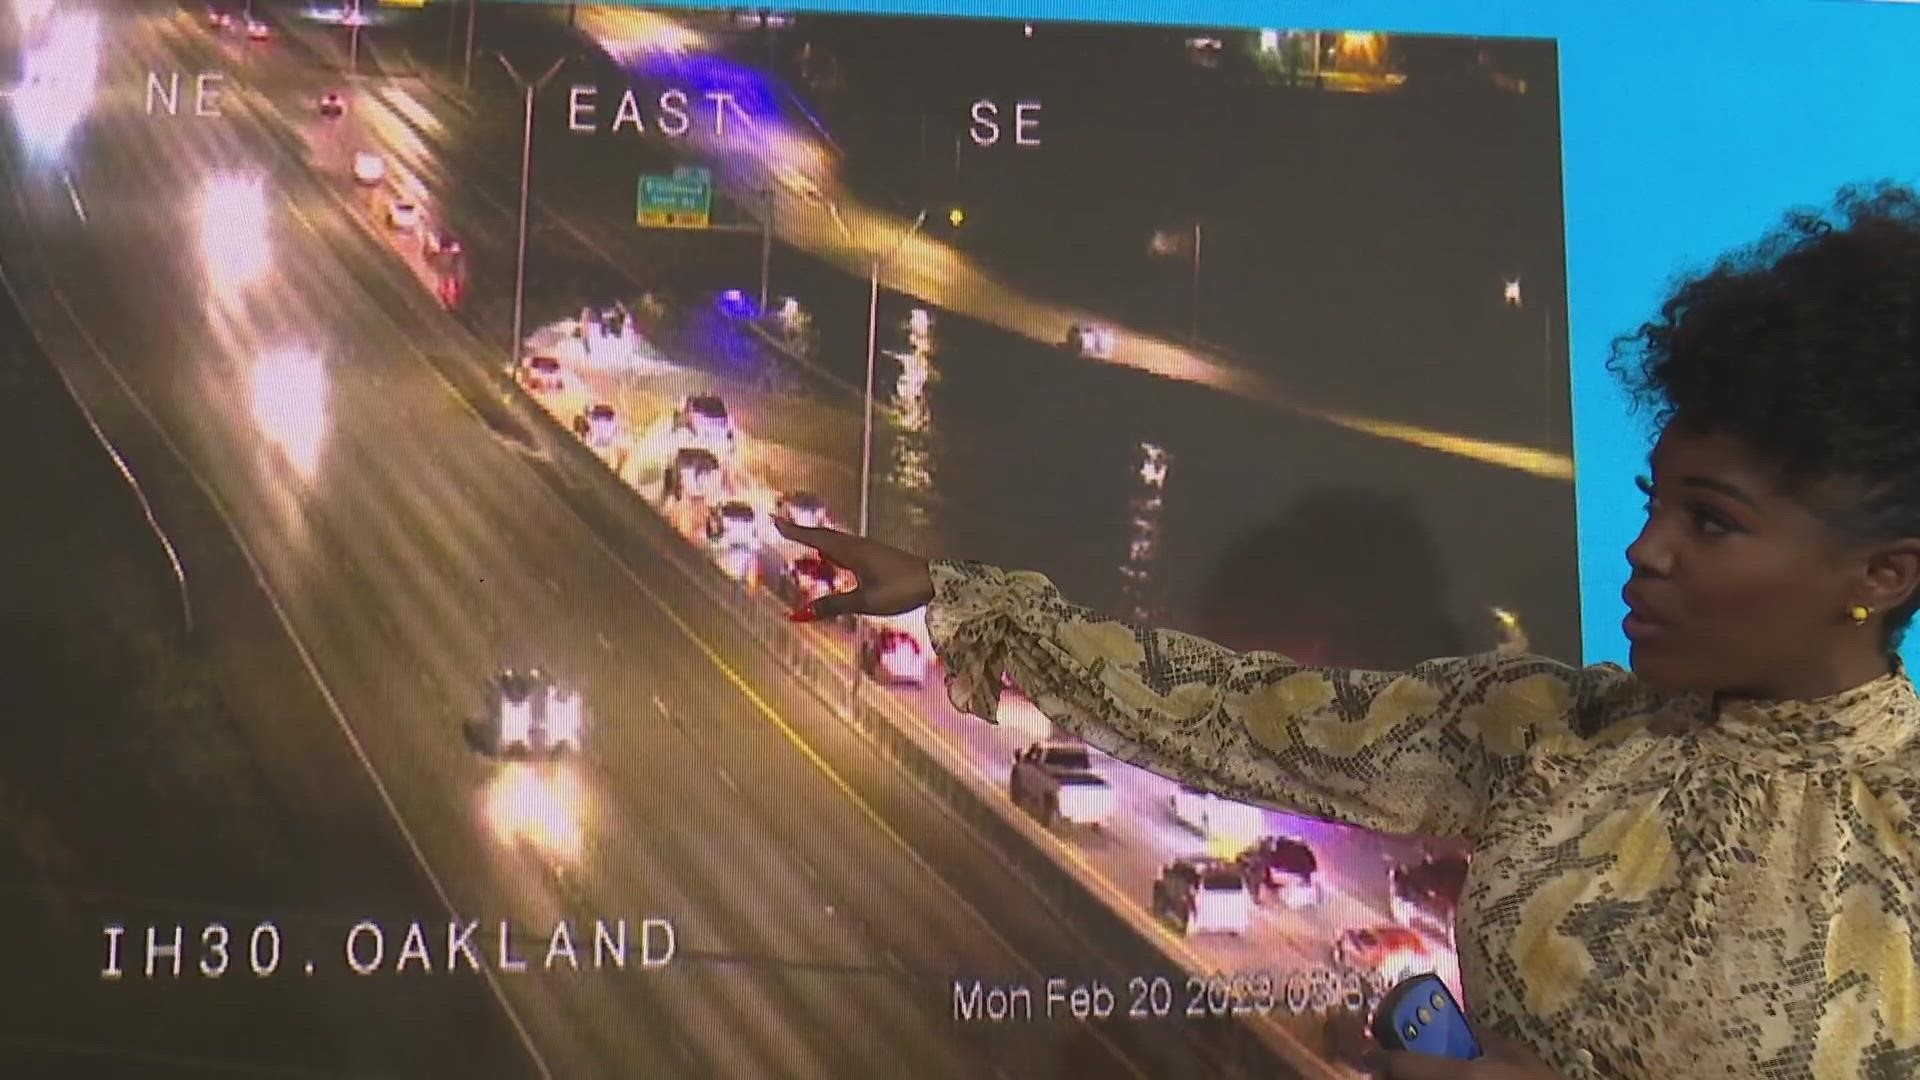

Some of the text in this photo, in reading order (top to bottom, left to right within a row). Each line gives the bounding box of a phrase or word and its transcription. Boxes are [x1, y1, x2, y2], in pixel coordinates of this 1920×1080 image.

[146, 71, 224, 116] NE
[568, 84, 736, 138] EAST
[969, 100, 1042, 146] SE
[953, 979, 1032, 1022] Mon
[1046, 977, 1115, 1018] Feb
[1128, 976, 1172, 1018] 20
[1185, 973, 1275, 1016] 2023
